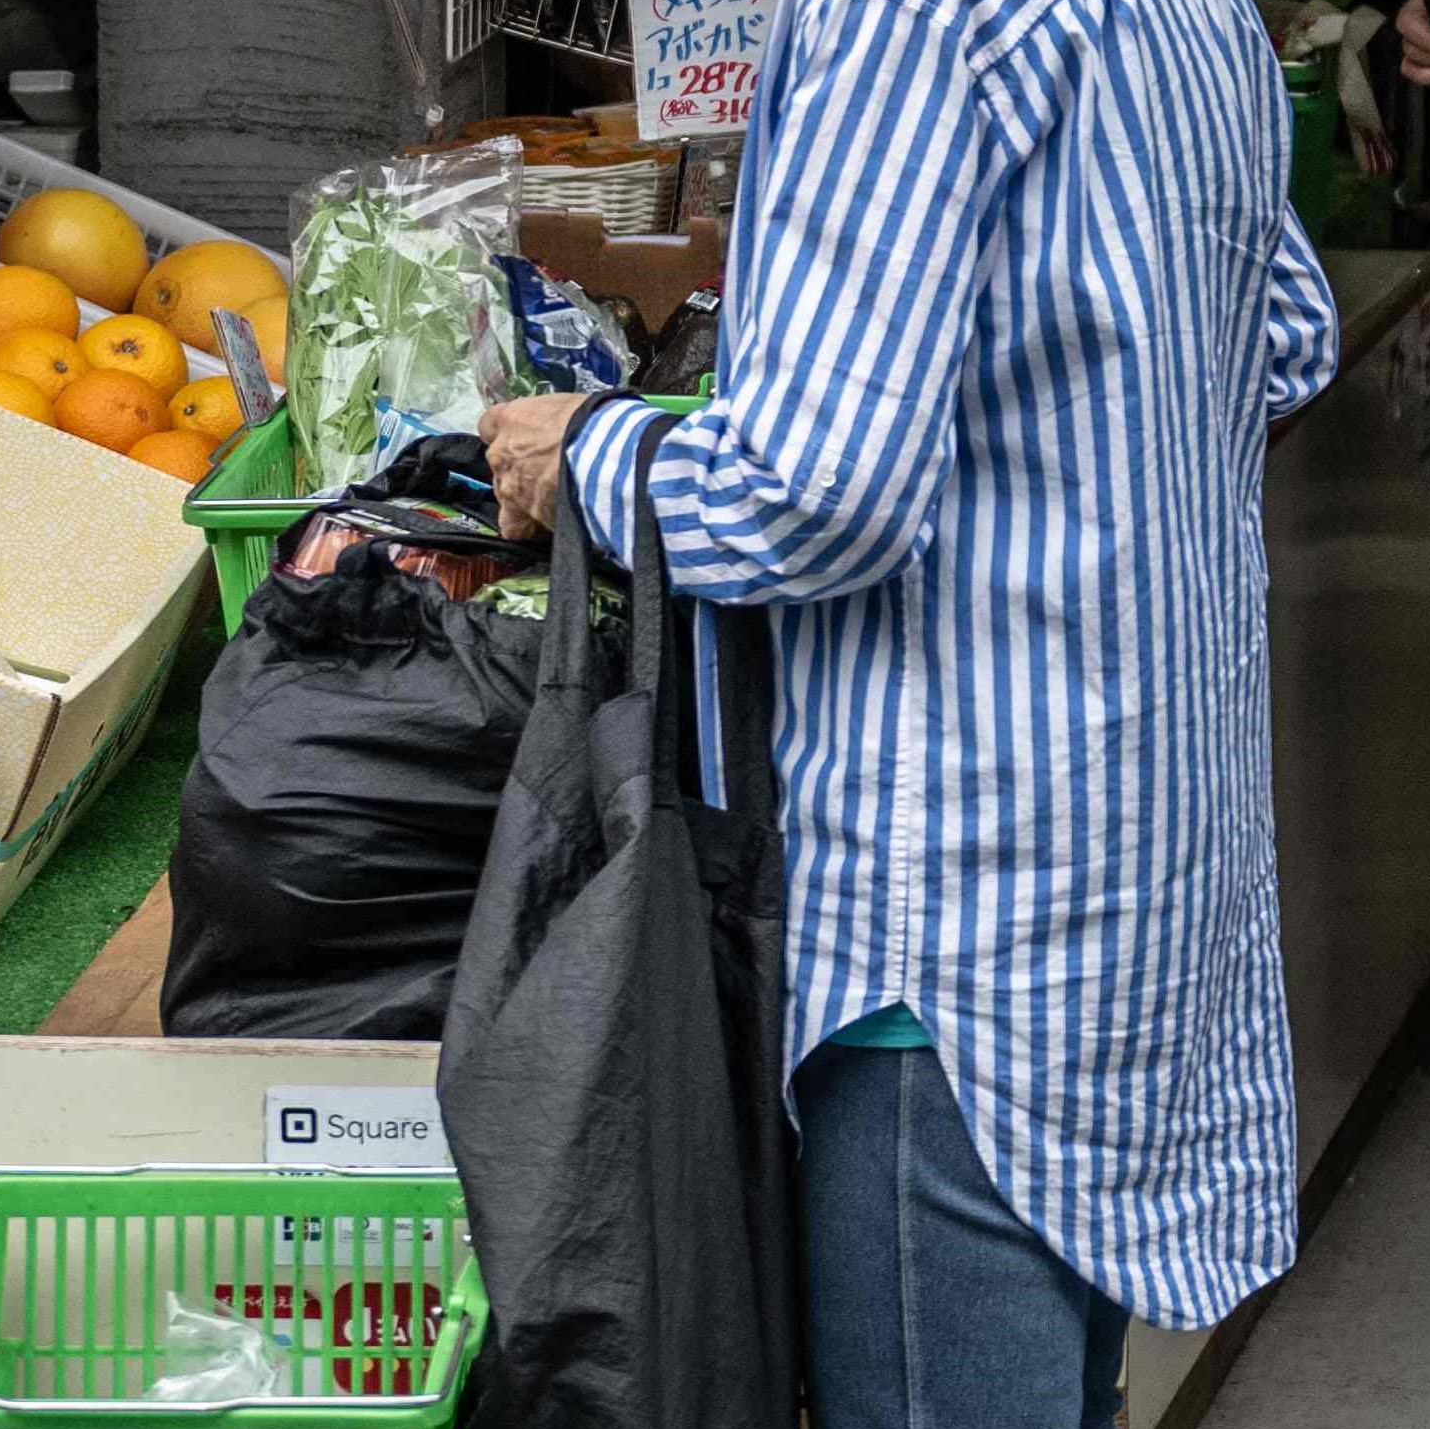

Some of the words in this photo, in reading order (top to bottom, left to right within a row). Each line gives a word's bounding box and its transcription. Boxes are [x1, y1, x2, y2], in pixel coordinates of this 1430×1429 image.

[645, 14, 765, 62] アボカド
[327, 1114, 429, 1145] Square
